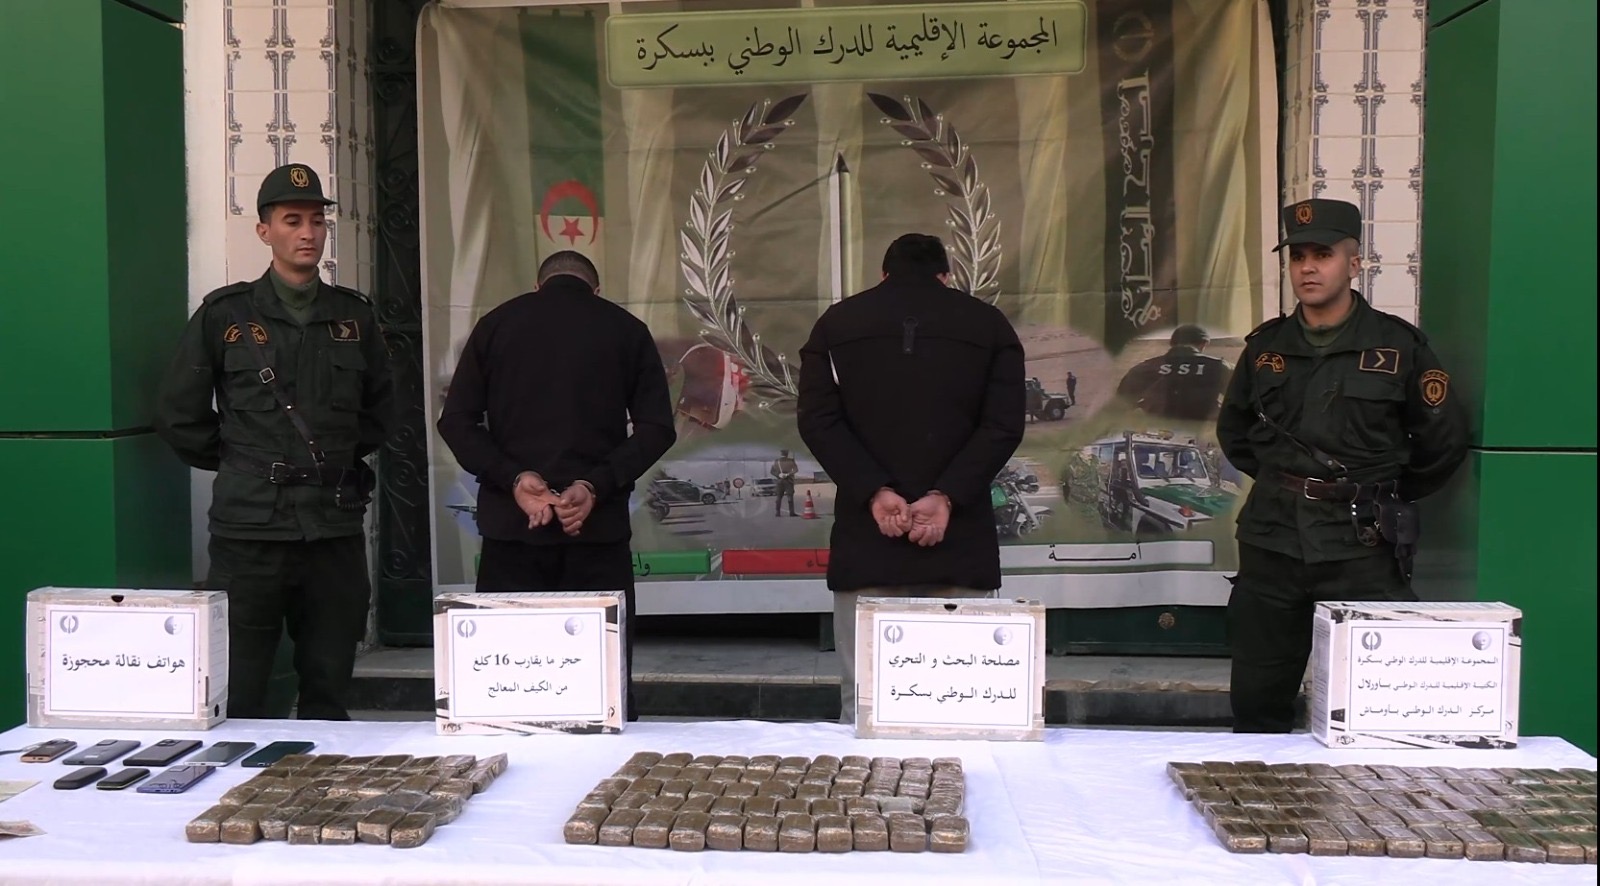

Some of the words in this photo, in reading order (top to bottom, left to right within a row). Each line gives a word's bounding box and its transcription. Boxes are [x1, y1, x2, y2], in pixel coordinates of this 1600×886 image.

[886, 13, 966, 61] الإقليمية
[977, 16, 1057, 60] المجموعة
[813, 24, 874, 64] للدرك
[728, 27, 801, 75] الوطني
[1158, 363, 1205, 375] SSI
[62, 654, 111, 672] محجوزة
[115, 654, 141, 668] نقالة
[146, 656, 186, 674] هواتف
[472, 655, 492, 672] كلغ
[494, 654, 510, 666] 16
[514, 656, 543, 669] يقارب
[546, 656, 555, 665] ما
[558, 658, 582, 669] حجز
[888, 653, 926, 668] التحري
[930, 658, 938, 669] و
[942, 654, 977, 668] البحث
[981, 656, 1020, 667] مصلحة
[1357, 655, 1383, 666] بسكرة
[1408, 656, 1428, 667] للدرك
[1461, 658, 1499, 667] المجموعة
[487, 682, 520, 699] المعالج
[523, 680, 552, 694] الكيف
[555, 686, 568, 696] من
[890, 684, 932, 701] بسكرة
[1419, 682, 1441, 691] للدرك
[936, 687, 978, 704] الوطني
[982, 687, 1017, 704] للدرك
[1401, 706, 1435, 719] الوطني
[1436, 706, 1462, 717] الدرك
[1468, 705, 1495, 718] مركز
